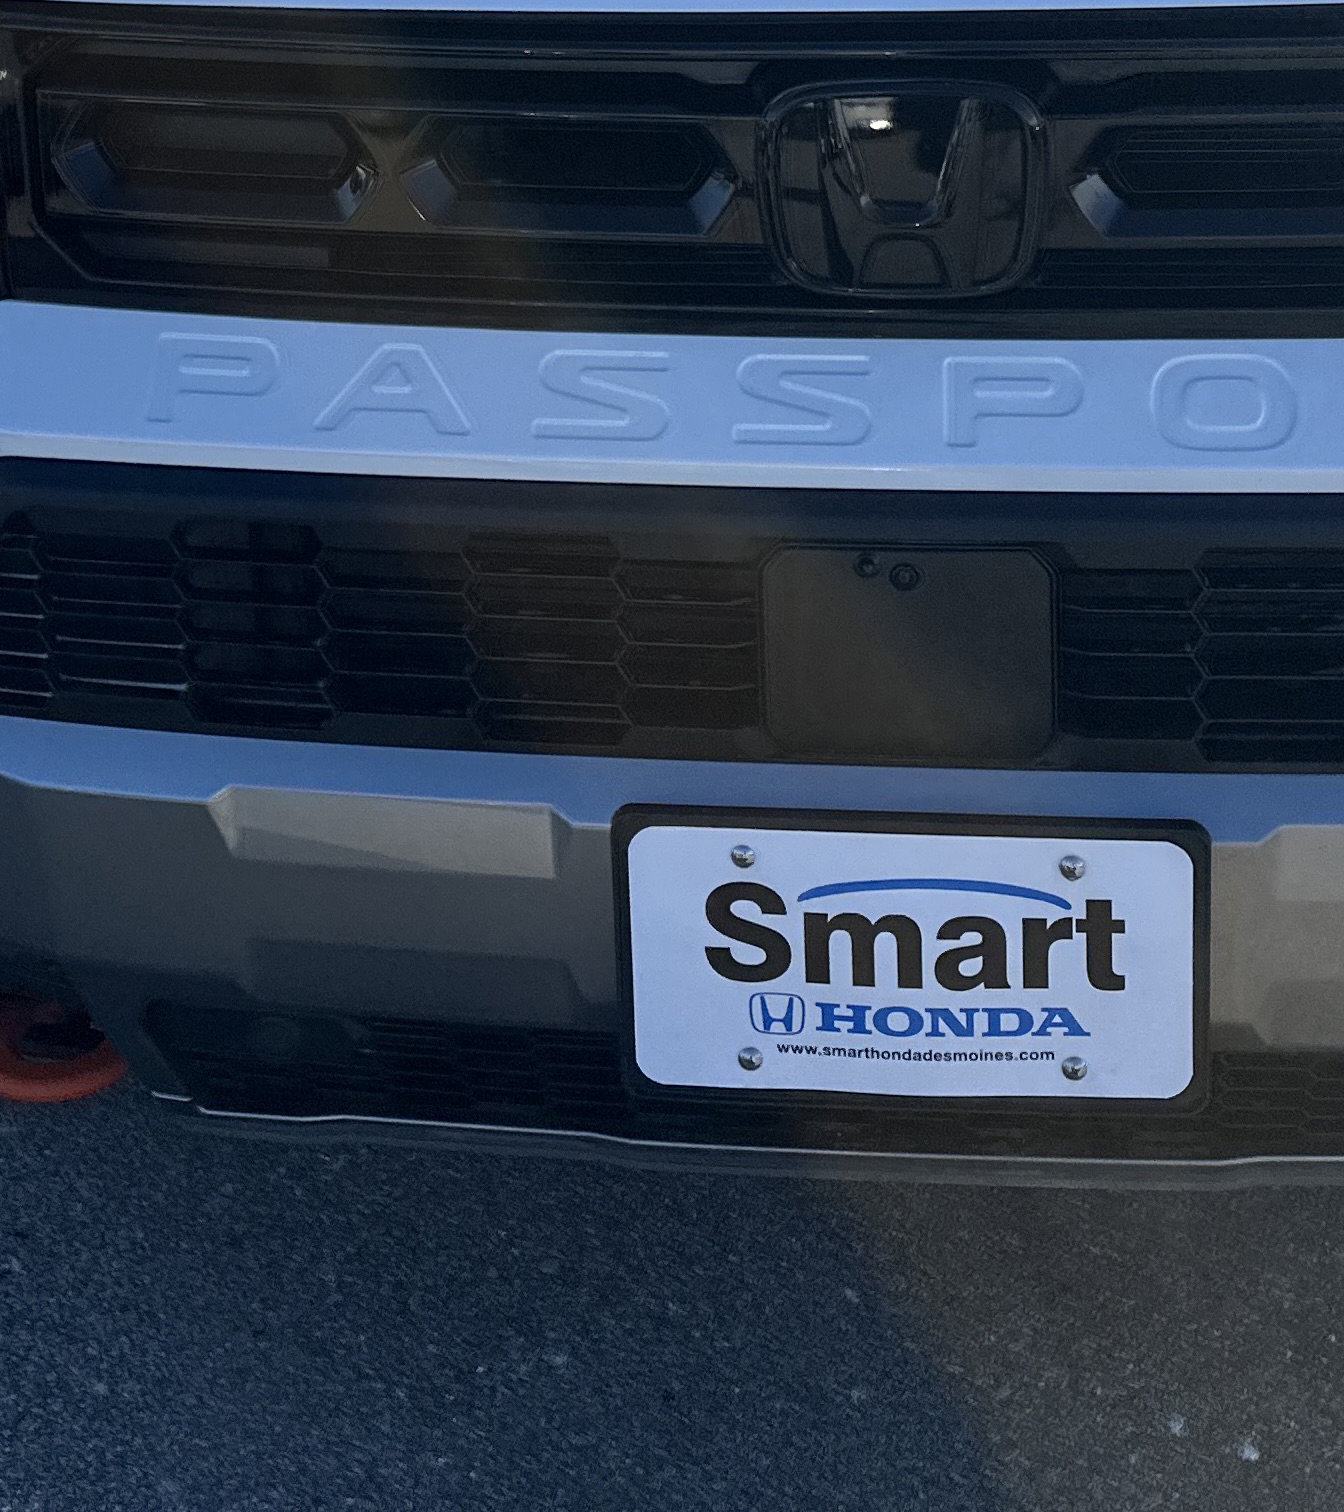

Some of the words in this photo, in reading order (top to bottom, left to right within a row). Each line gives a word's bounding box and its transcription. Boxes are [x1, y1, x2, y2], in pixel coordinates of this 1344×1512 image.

[704, 881, 1126, 992] Smart
[815, 1001, 1091, 1038] HONDA
[776, 1042, 1055, 1063] www.smarthondadesmoines.com
